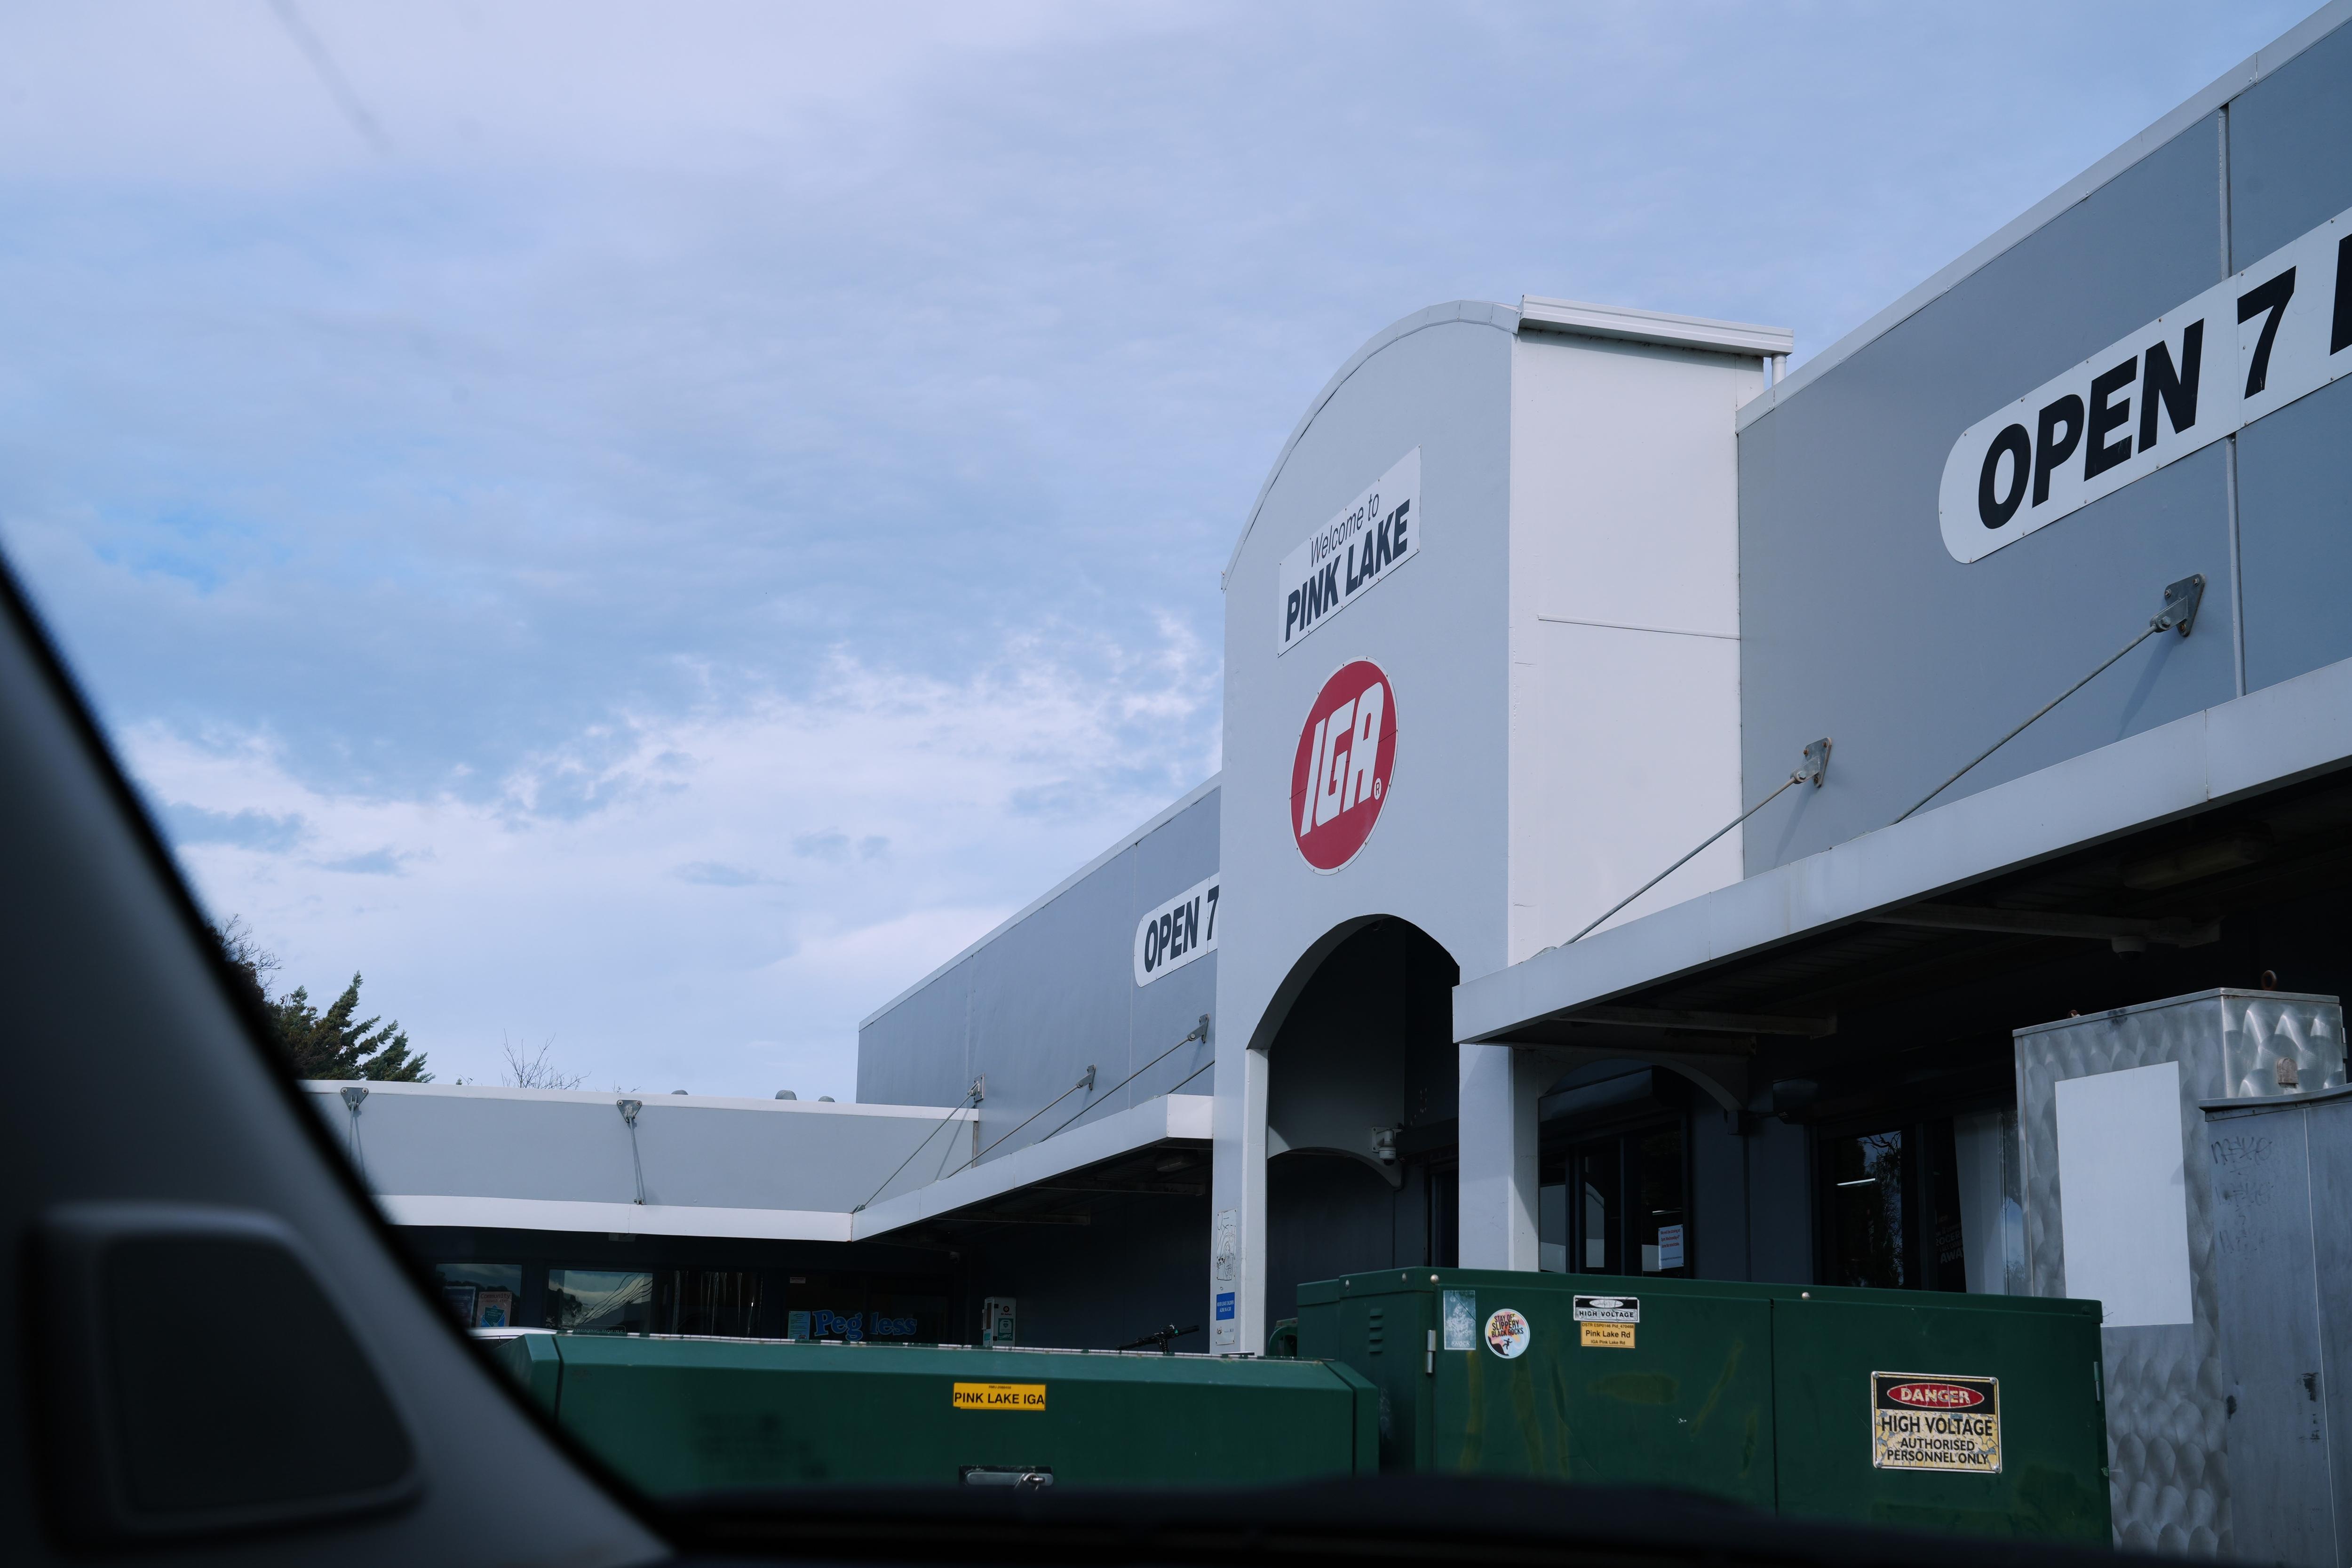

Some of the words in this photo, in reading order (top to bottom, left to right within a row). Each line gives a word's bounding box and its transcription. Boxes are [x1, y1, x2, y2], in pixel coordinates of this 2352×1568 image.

[1978, 318, 2204, 529] OPEN
[2237, 265, 2296, 400] 7
[1311, 506, 1364, 567] Welcome
[1368, 493, 1379, 521] to
[1285, 554, 1341, 643] PINK
[1345, 499, 1410, 597] LAKE
[1300, 682, 1384, 837] IGA
[1144, 896, 1200, 972] OPEN
[1207, 884, 1219, 941] 7
[1940, 1248, 1963, 1264] AWA
[812, 1310, 864, 1341] Peg
[870, 1312, 917, 1336] less
[1492, 1320, 1519, 1331] SLIPPERY
[1508, 1328, 1524, 1337] ROCKS
[954, 1393, 984, 1403] PINK
[988, 1393, 1019, 1404] LAKE
[1024, 1394, 1044, 1405] IGA
[1900, 1387, 1971, 1404] DANGER
[1882, 1415, 1920, 1433] HIGH
[1925, 1417, 1993, 1436] VOLTAGE
[1900, 1438, 1975, 1451] AUTHORISED
[1887, 1450, 1955, 1463] PERSONNEL
[1958, 1452, 1988, 1465] ONLY
